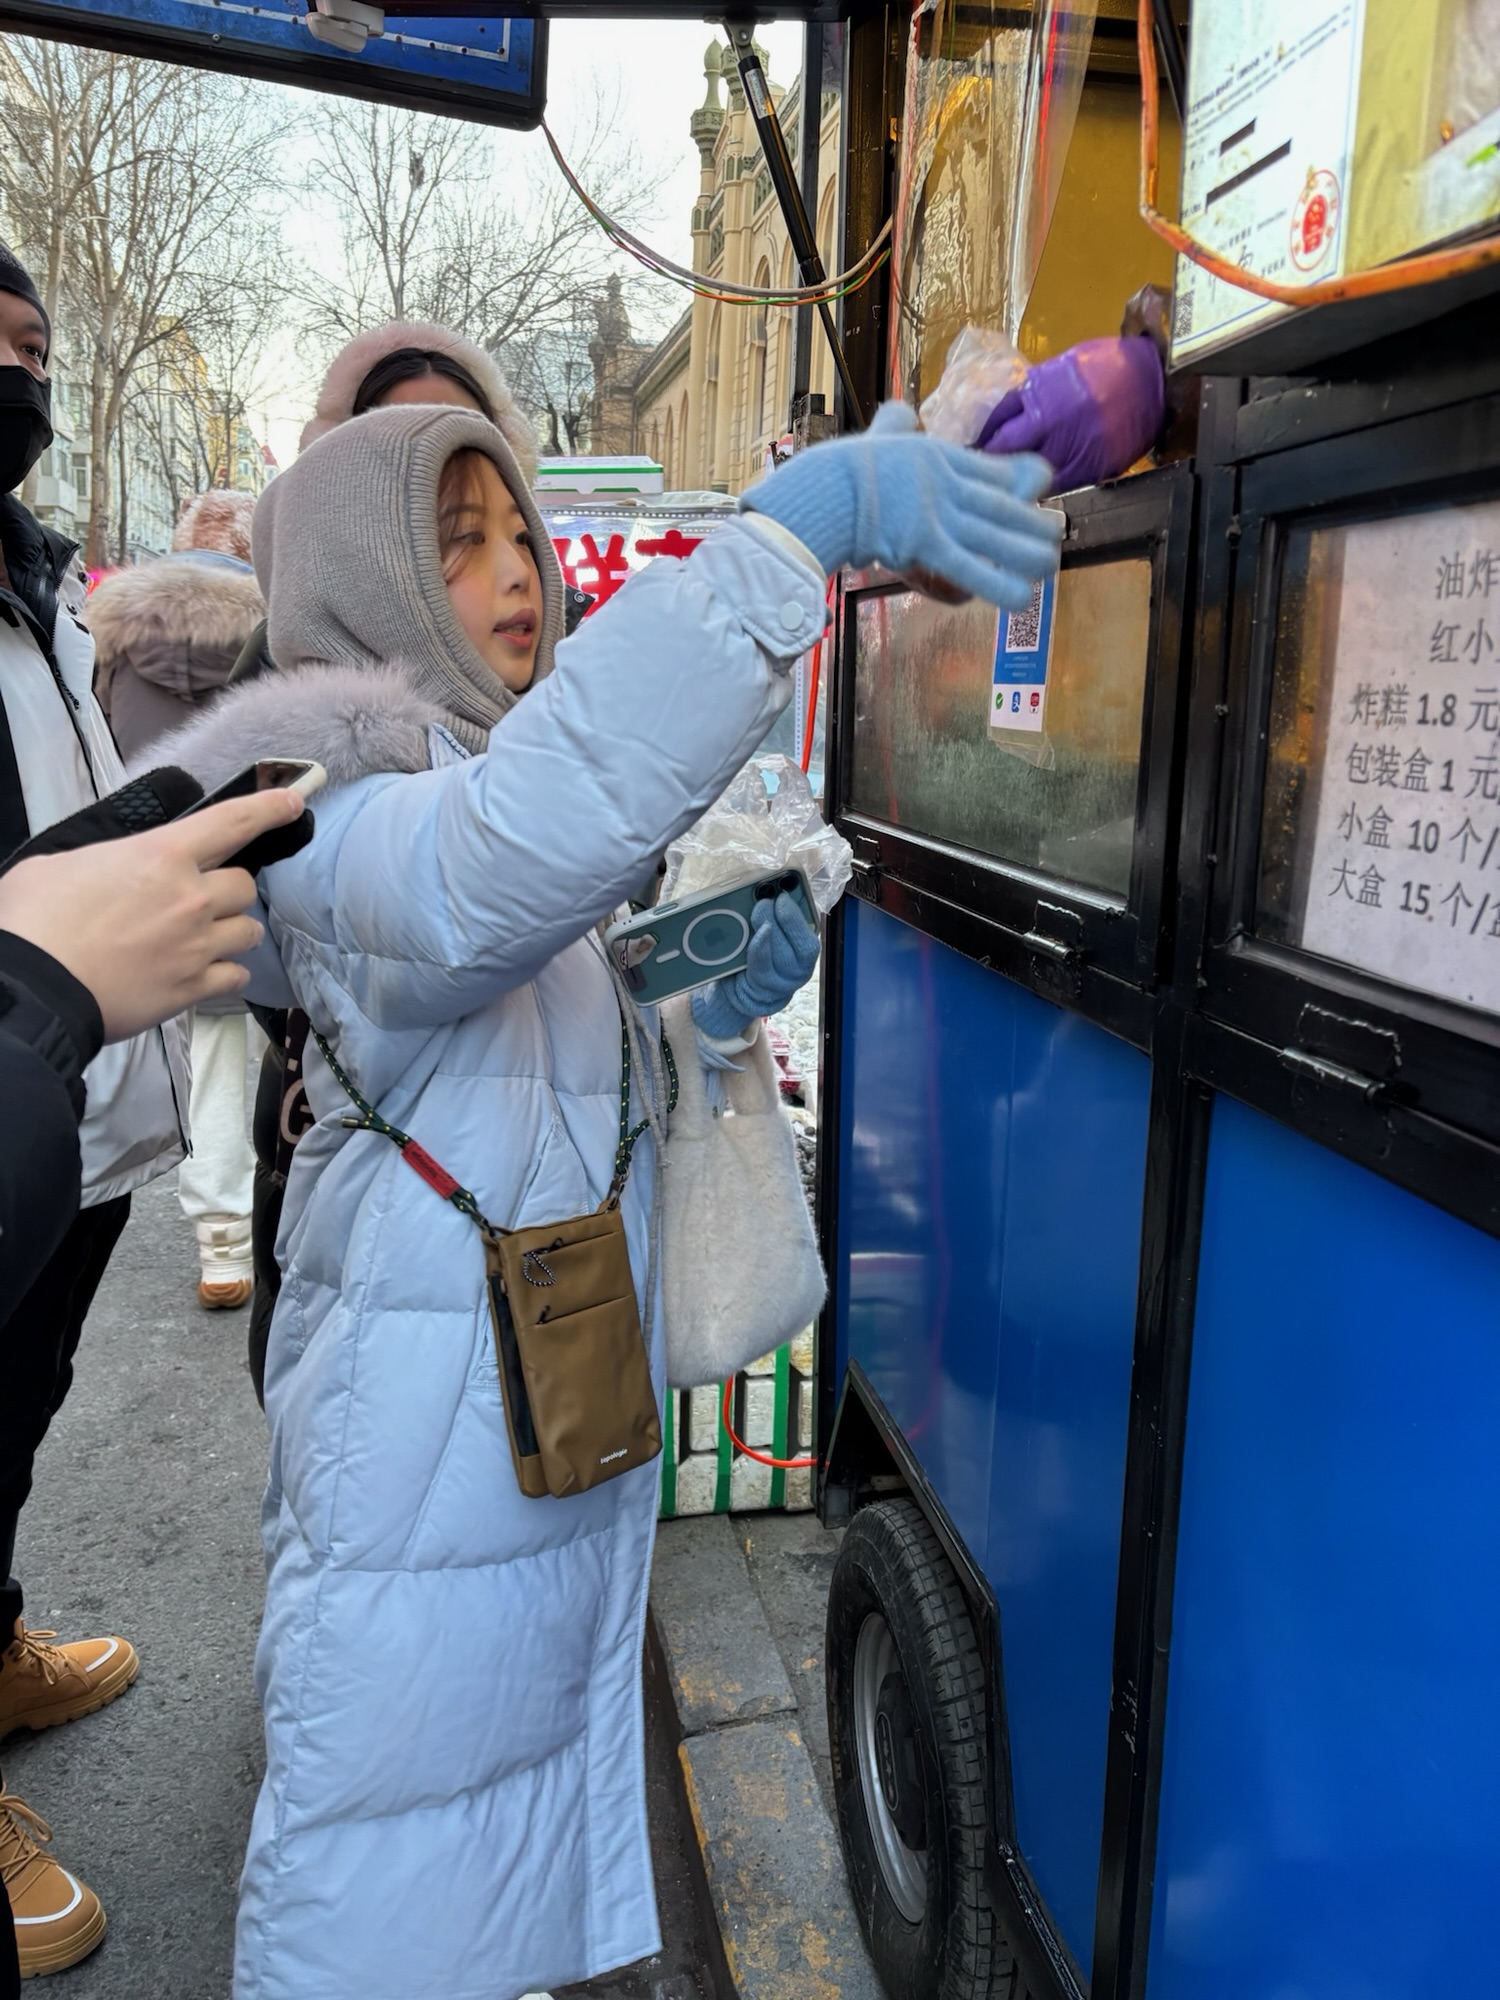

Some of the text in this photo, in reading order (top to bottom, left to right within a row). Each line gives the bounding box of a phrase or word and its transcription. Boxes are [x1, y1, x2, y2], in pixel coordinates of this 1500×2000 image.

[1435, 550, 1500, 599] 油炸
[1429, 618, 1500, 664] 红小
[1350, 683, 1500, 738] 炸糕 1.8 元
[1347, 742, 1500, 806] 包装盒 1 元
[1337, 801, 1500, 871] 小盒 10 个/
[1328, 858, 1386, 908] 大盒
